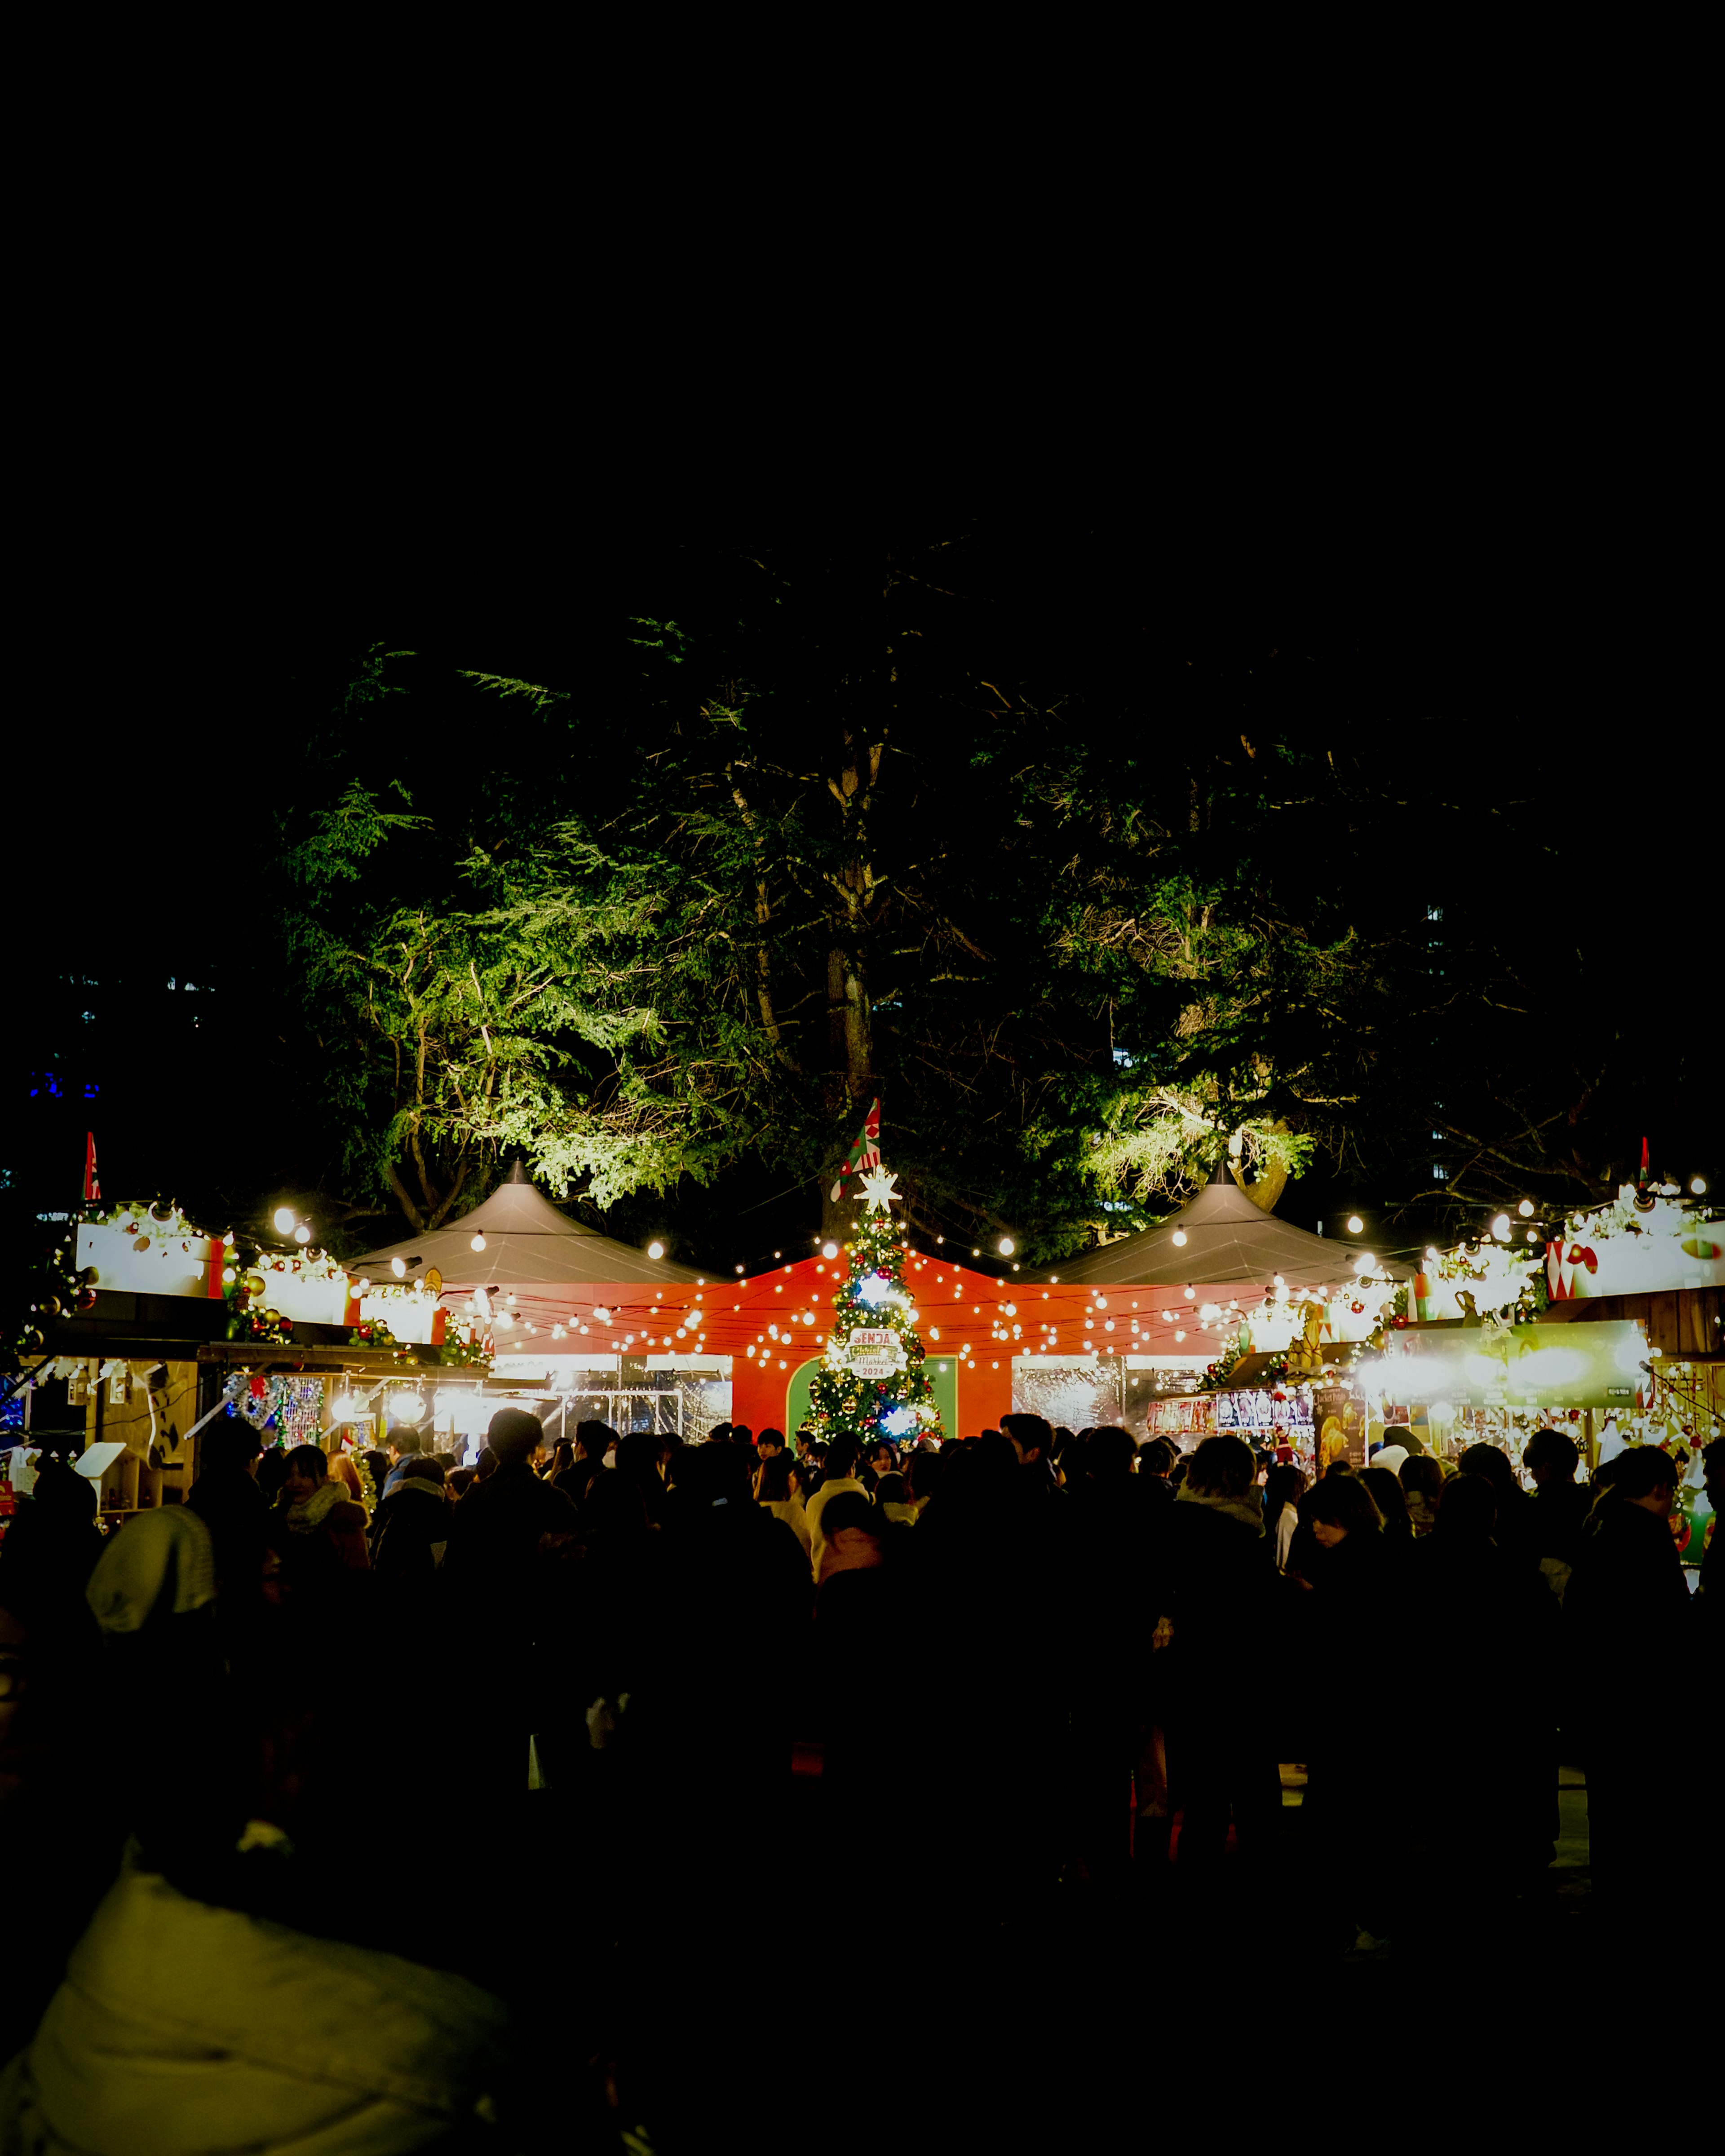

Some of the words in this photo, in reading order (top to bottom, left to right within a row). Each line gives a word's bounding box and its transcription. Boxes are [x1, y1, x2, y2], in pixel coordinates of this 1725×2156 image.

[854, 1333, 893, 1344] SENDA
[852, 1346, 894, 1357] Christas
[856, 1356, 888, 1365] Market
